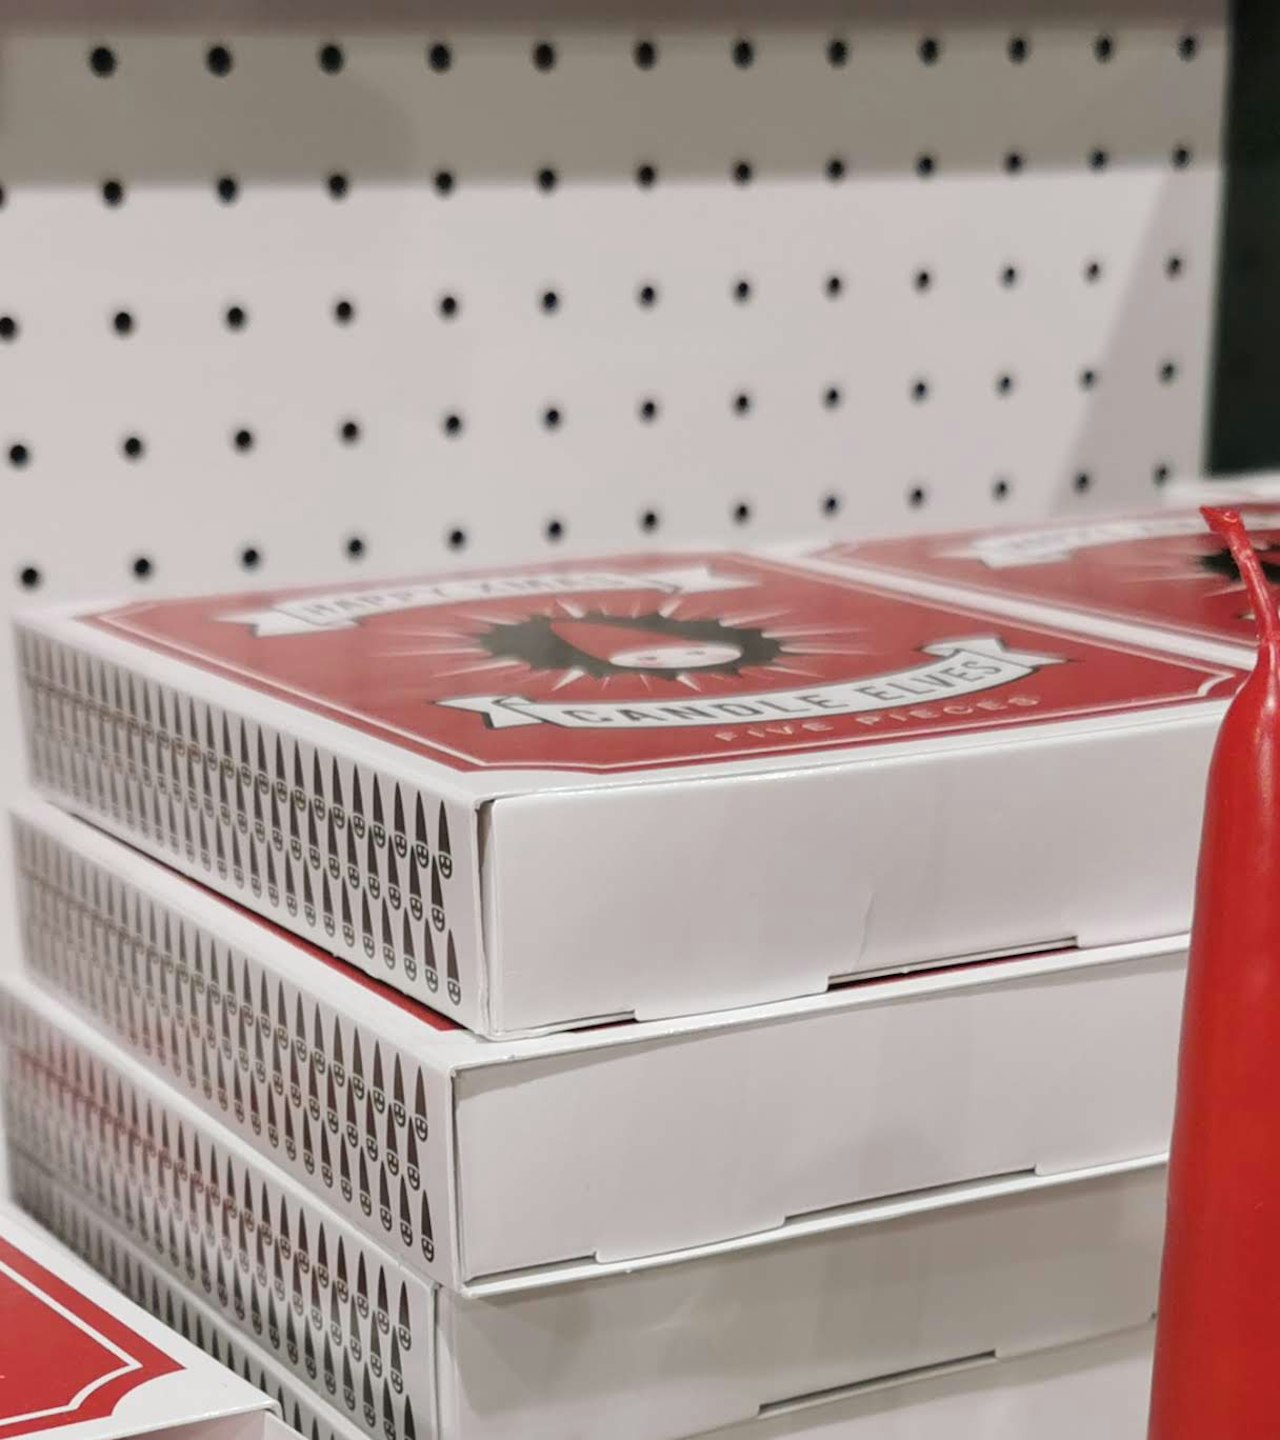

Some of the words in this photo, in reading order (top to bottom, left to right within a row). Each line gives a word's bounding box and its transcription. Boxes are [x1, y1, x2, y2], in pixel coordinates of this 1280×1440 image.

[561, 694, 851, 723] CANDLE
[860, 657, 1002, 703] ELVES
[713, 721, 834, 743] FIVE
[854, 694, 1041, 727] PIECES
